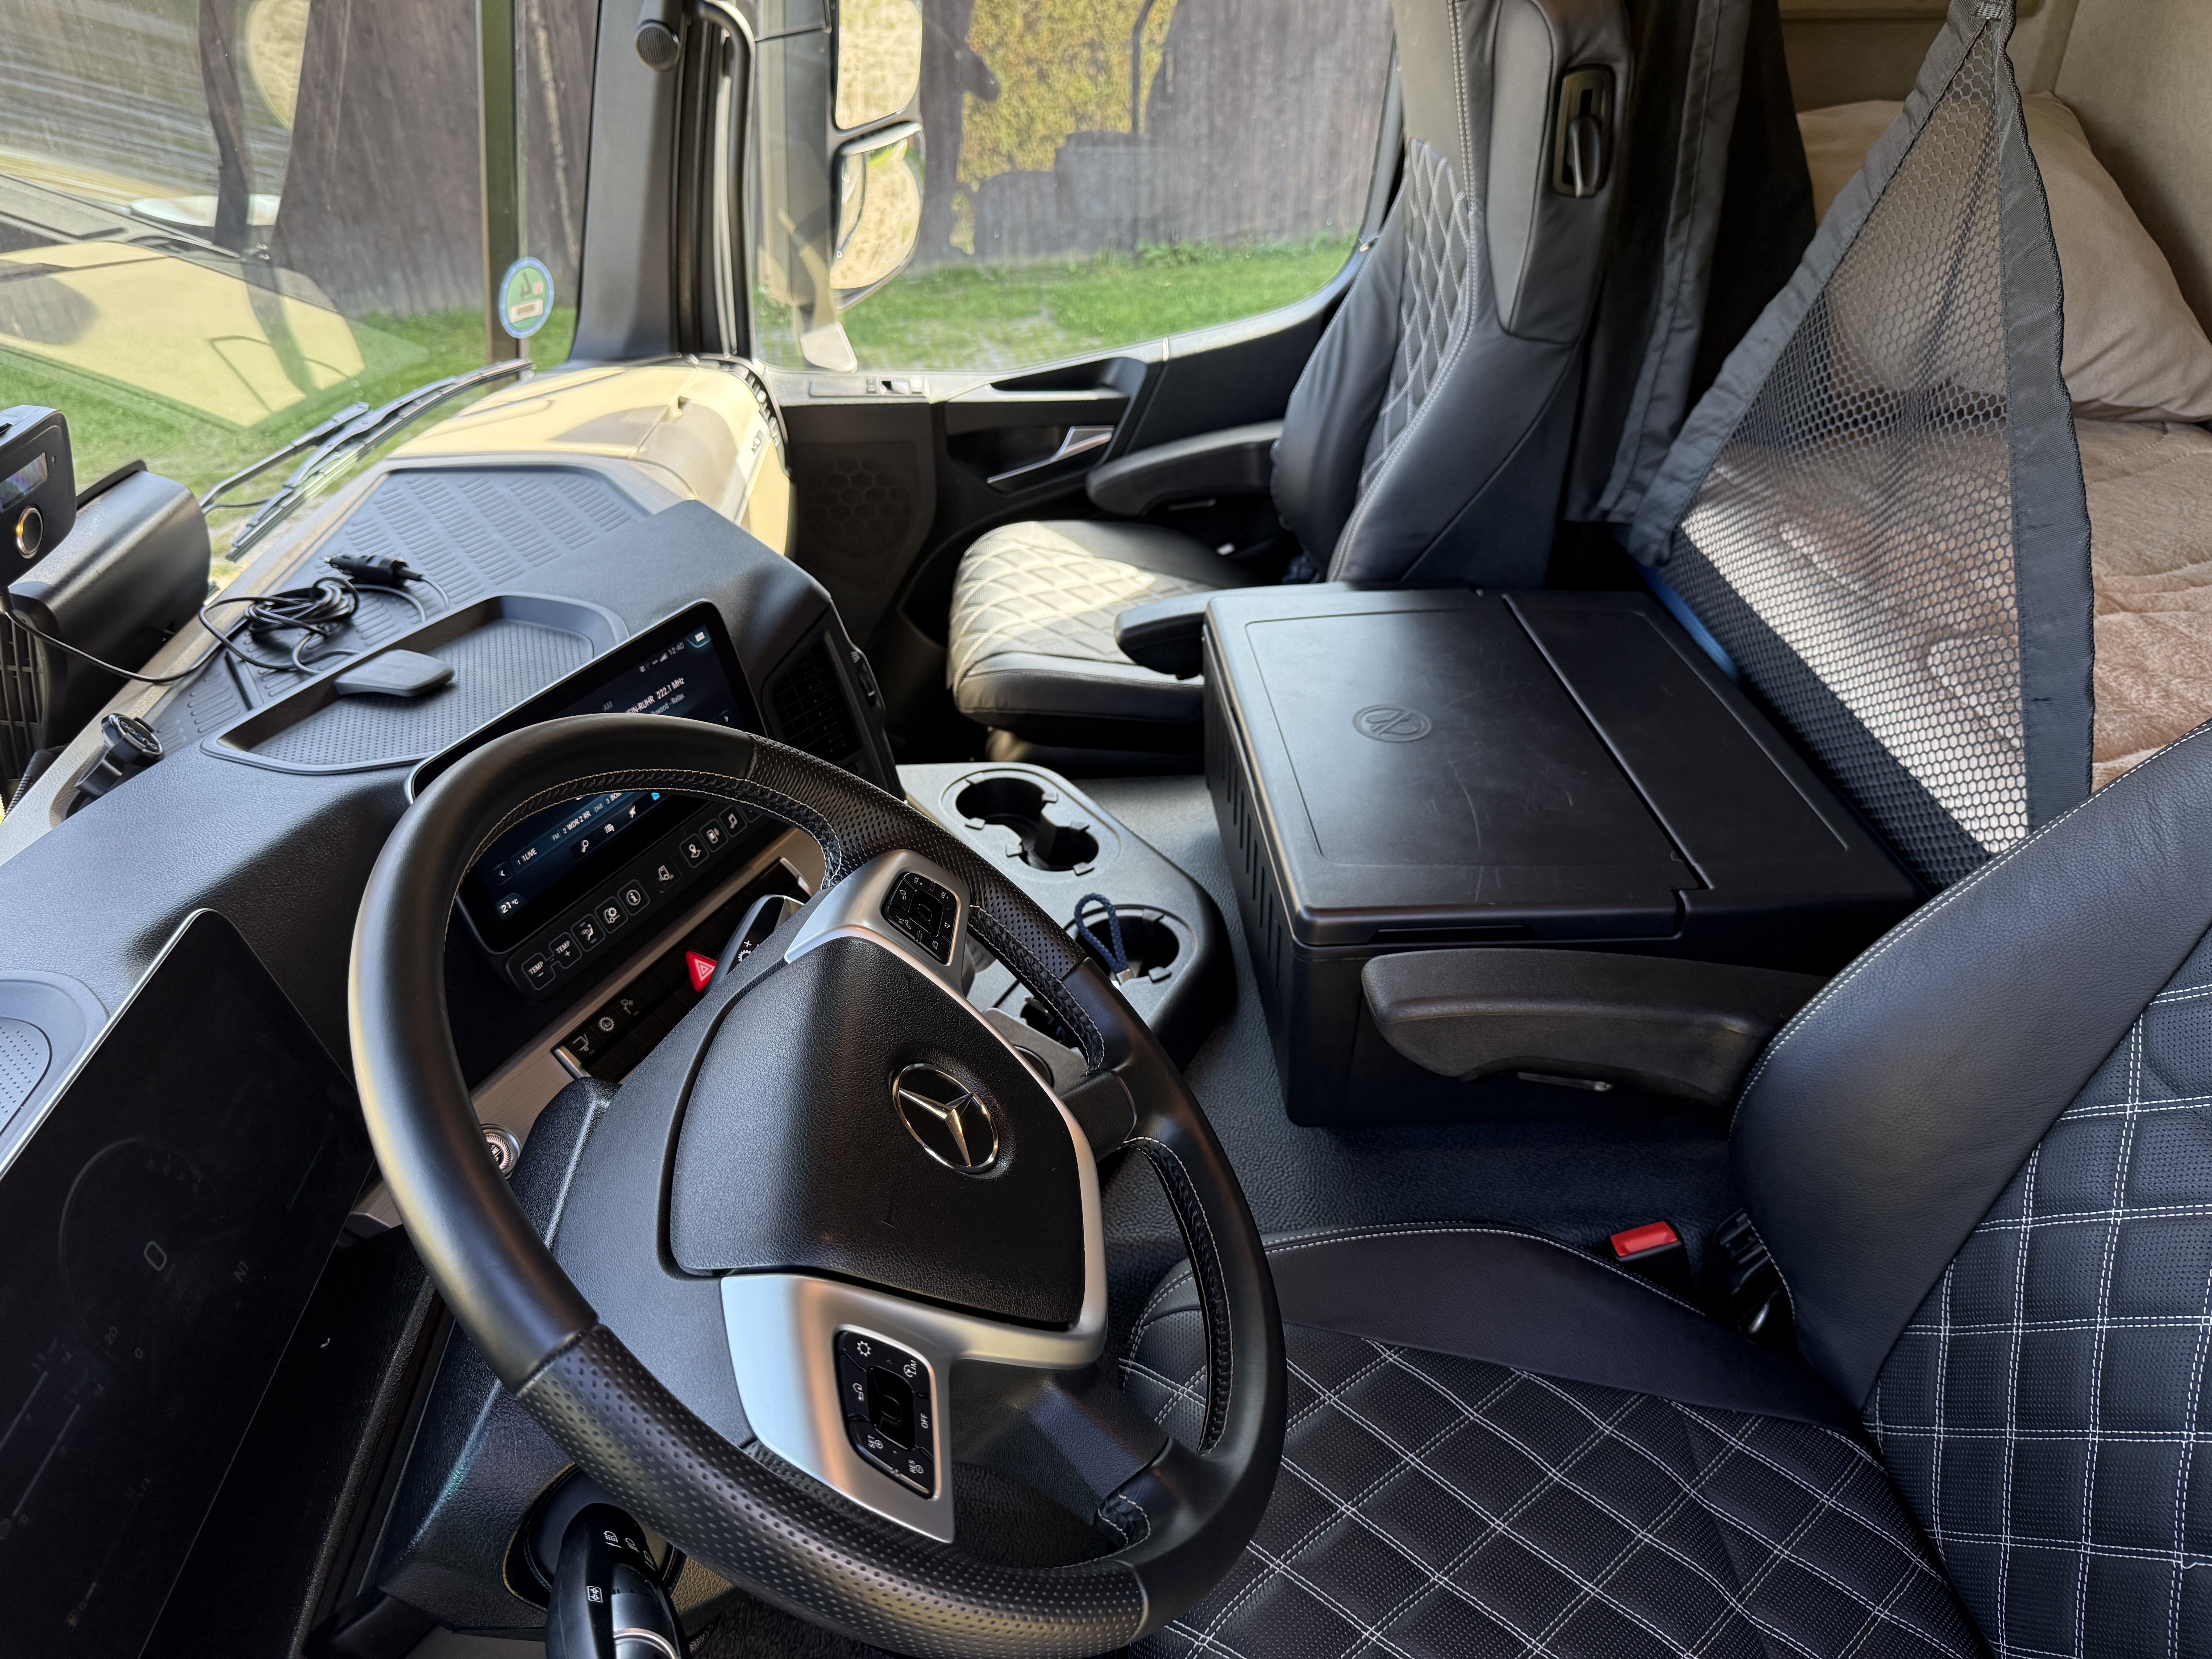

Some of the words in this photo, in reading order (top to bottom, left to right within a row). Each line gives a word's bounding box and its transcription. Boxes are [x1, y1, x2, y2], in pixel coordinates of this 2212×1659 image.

[655, 684, 672, 699] 222.1
[672, 677, 685, 690] MHz
[567, 818, 580, 831] WDR
[555, 940, 570, 954] TEMP
[527, 961, 544, 975] TEMP
[920, 1413, 928, 1429] OFF
[867, 1434, 876, 1449] SET
[907, 1459, 917, 1474] RES
